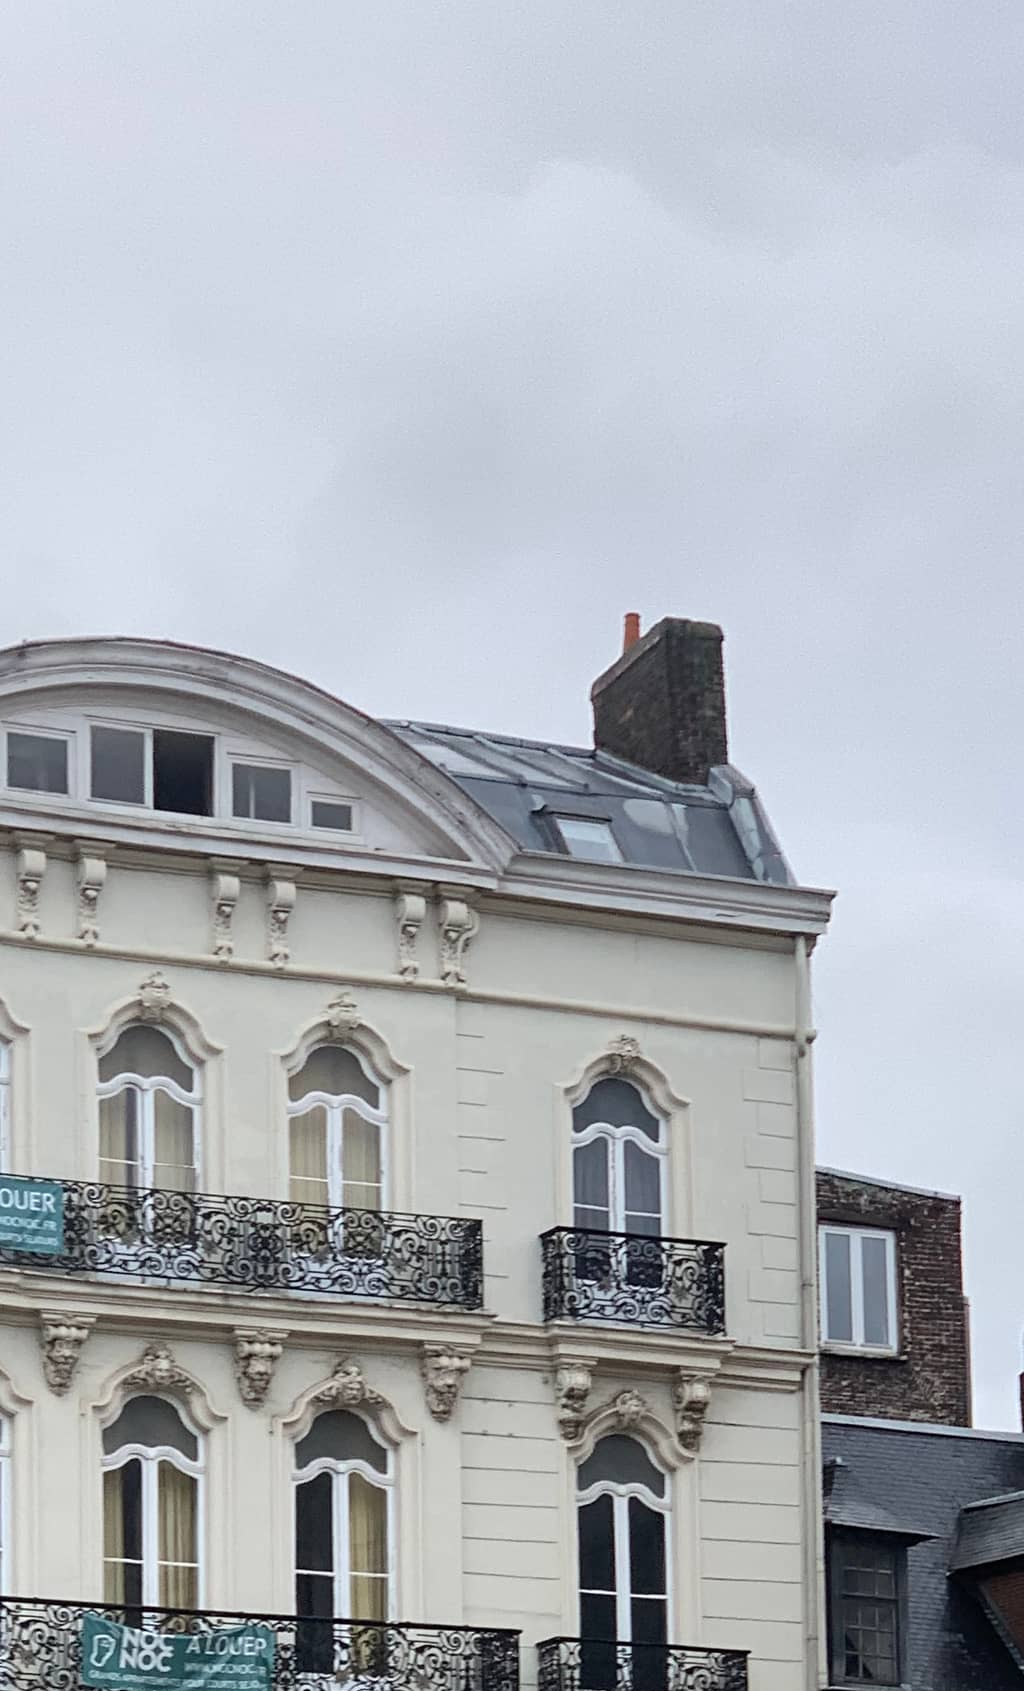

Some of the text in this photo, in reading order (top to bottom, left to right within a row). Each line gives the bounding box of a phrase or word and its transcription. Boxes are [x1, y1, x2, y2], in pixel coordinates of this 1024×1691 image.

[121, 1629, 175, 1652] NOC
[186, 1635, 201, 1654] A
[119, 1649, 175, 1673] NOC
